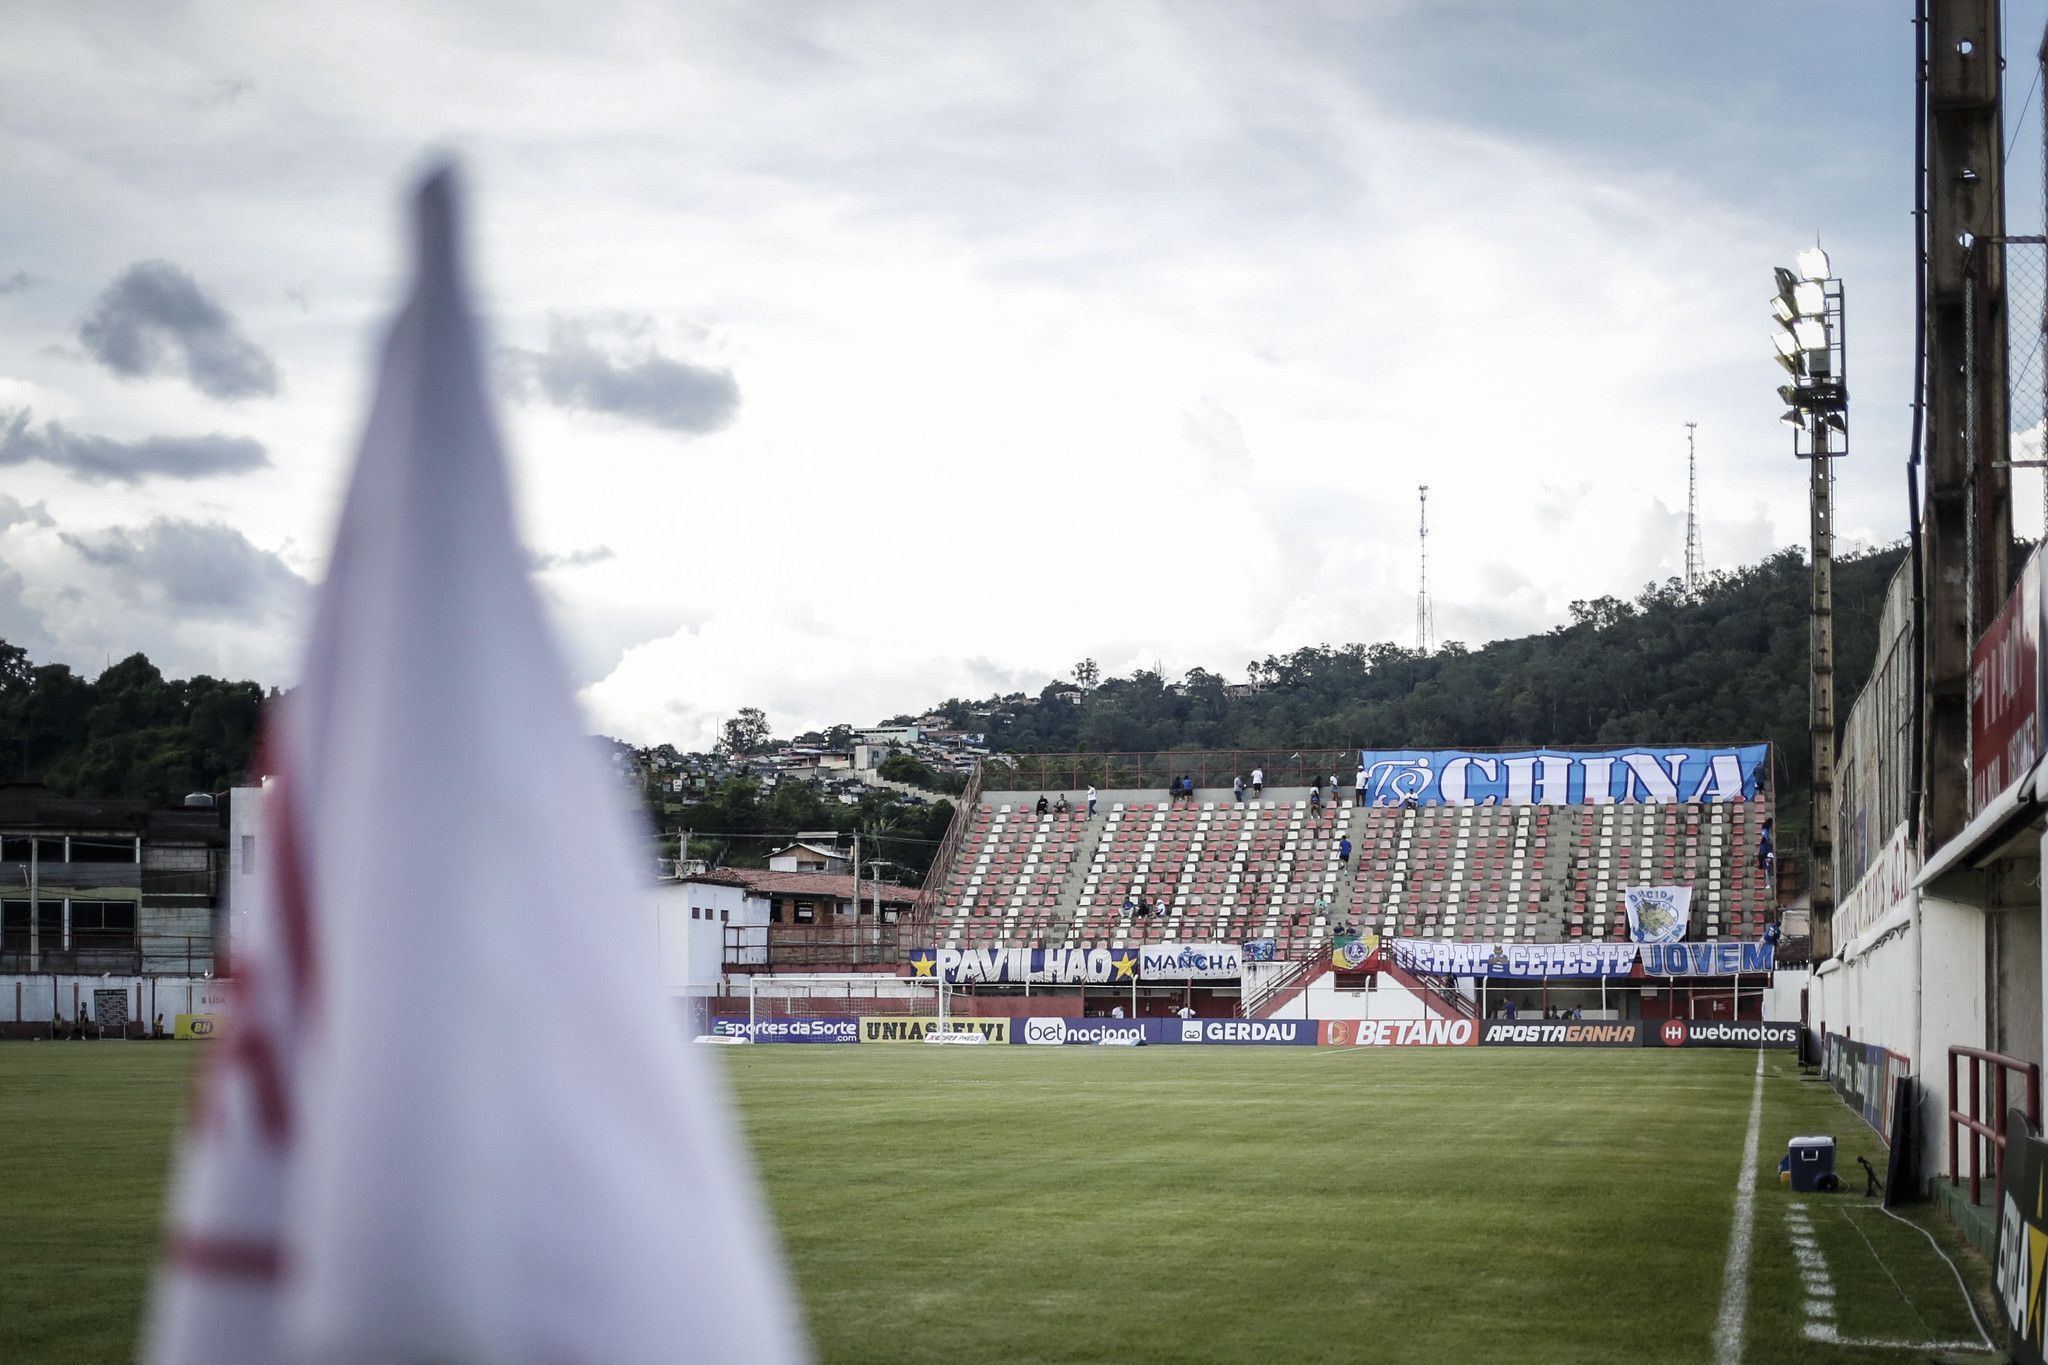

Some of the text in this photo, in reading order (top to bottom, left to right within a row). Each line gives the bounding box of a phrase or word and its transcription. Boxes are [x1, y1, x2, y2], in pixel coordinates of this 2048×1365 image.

[1438, 753, 1747, 805] CHINA
[1144, 955, 1237, 971] MANCHA
[1509, 944, 1634, 975] CELESTE
[1643, 943, 1775, 975] JOVEM
[1206, 1022, 1296, 1041] GERDAU
[1355, 1020, 1472, 1045] BETANO
[1690, 1024, 1796, 1042] webmotors
